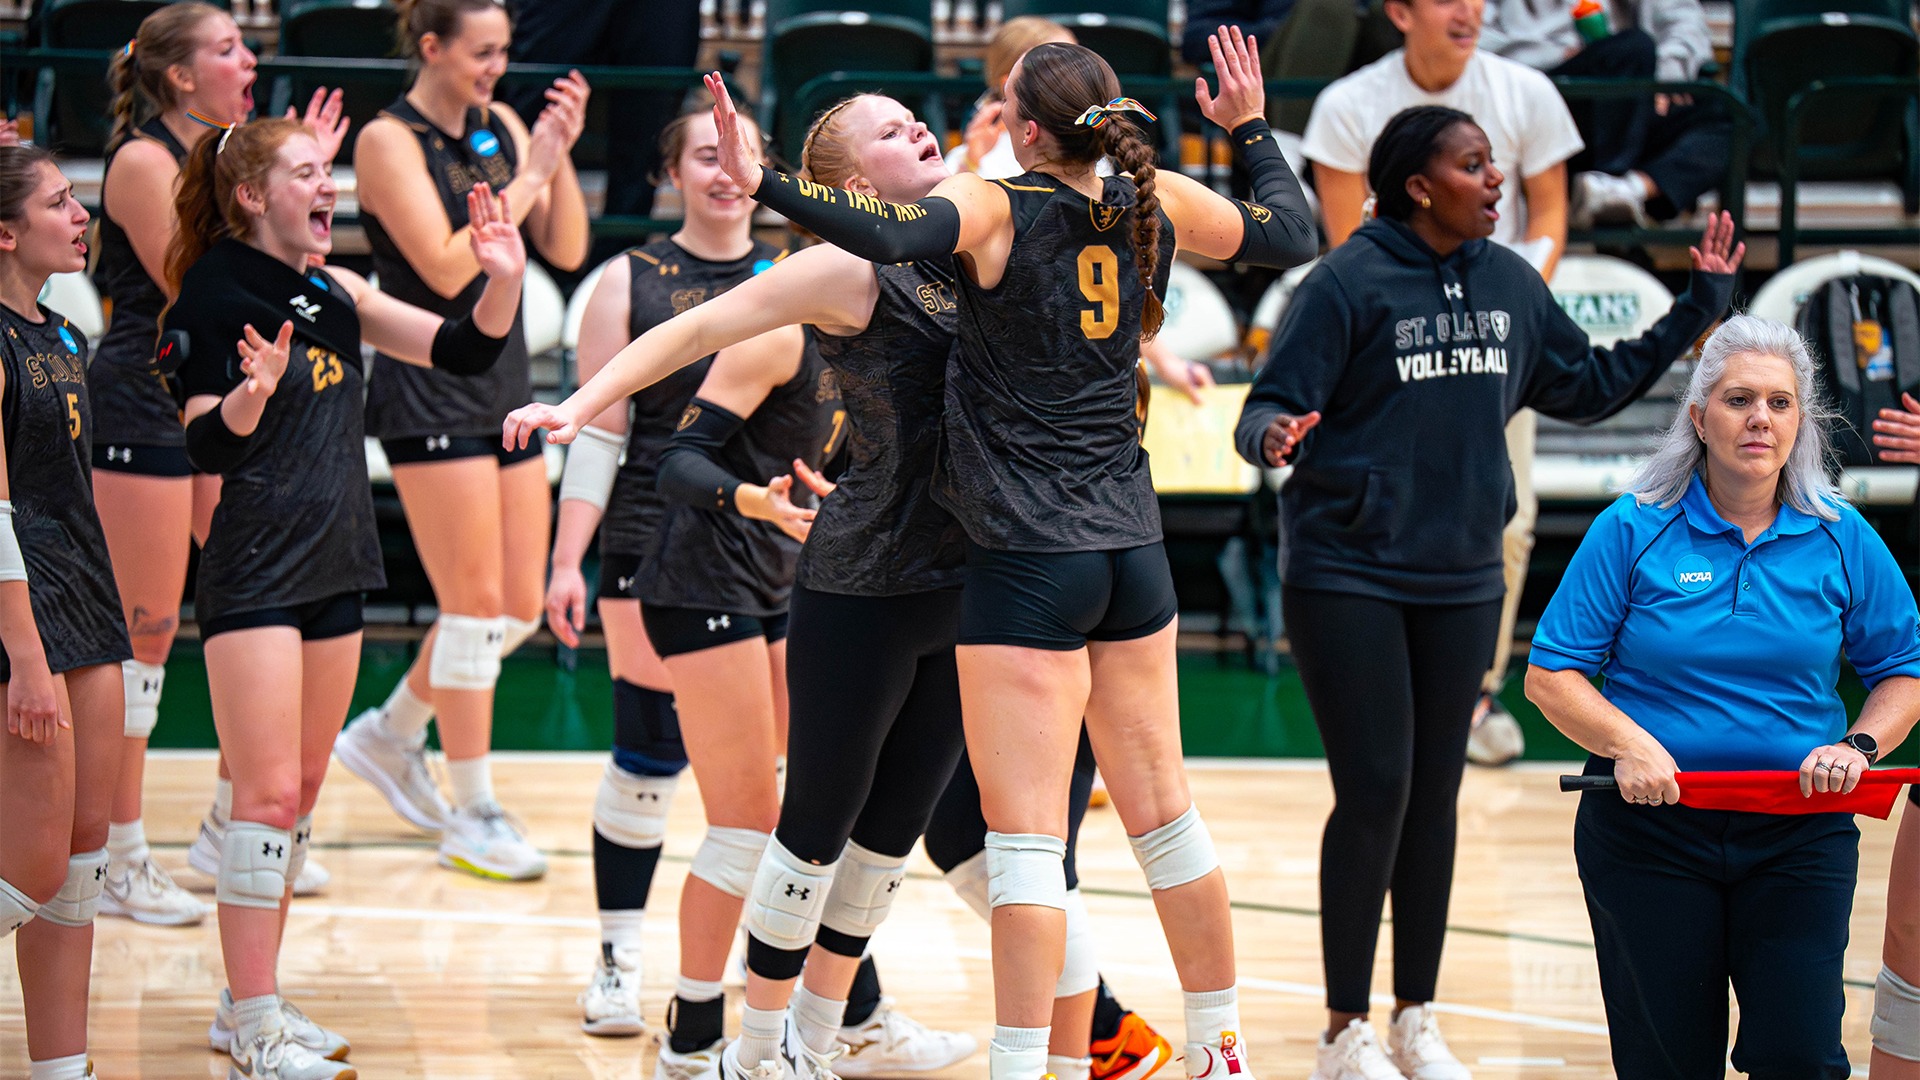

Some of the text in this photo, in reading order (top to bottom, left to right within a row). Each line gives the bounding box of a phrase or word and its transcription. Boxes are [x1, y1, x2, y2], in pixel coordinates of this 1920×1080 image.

[916, 281, 957, 315] ST.
[1077, 245, 1120, 340] 9
[1395, 311, 1491, 350] ST. OLAF
[306, 345, 344, 392] 23
[1395, 346, 1508, 383] VOLLEYBALL
[67, 393, 81, 441] 5
[1679, 571, 1713, 584] NCAA
